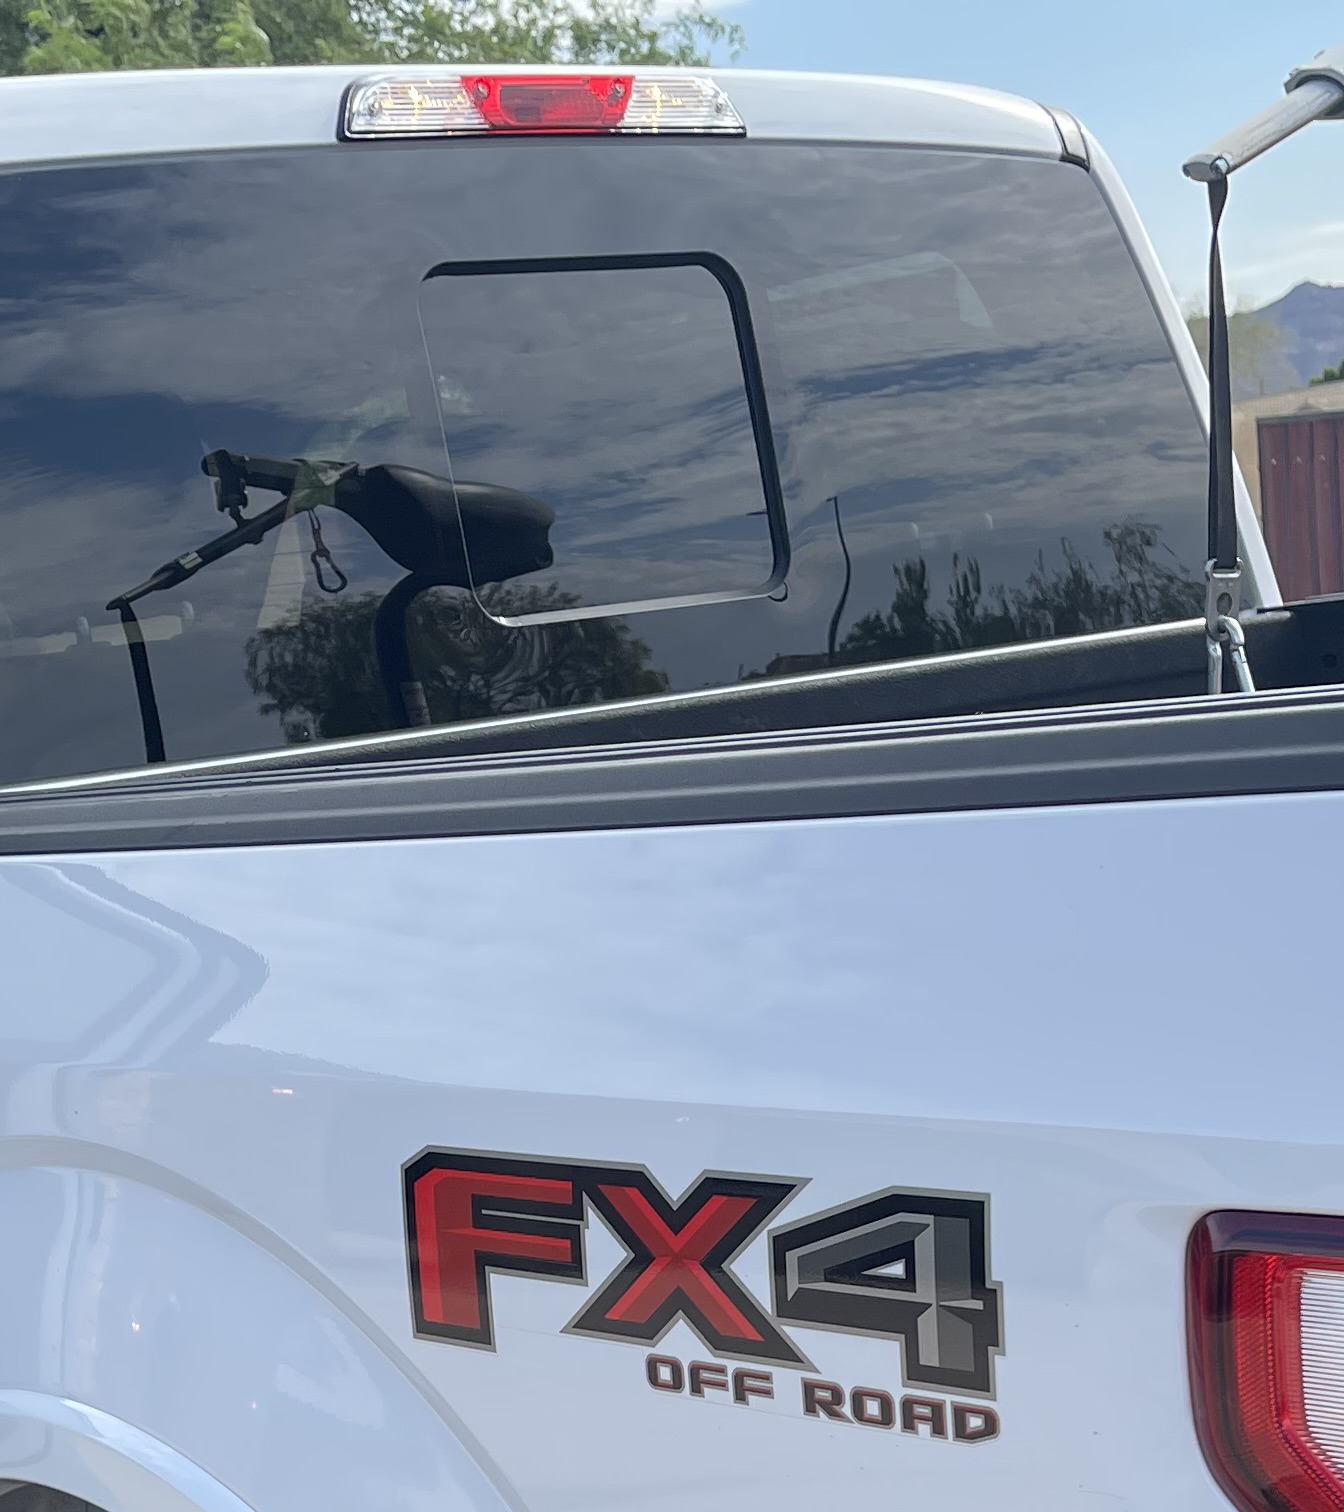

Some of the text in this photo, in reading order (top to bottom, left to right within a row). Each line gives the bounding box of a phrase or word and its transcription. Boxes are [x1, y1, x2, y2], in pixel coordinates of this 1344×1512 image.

[401, 1144, 1005, 1401] FX4
[646, 1353, 1000, 1446] OFF ROAD
